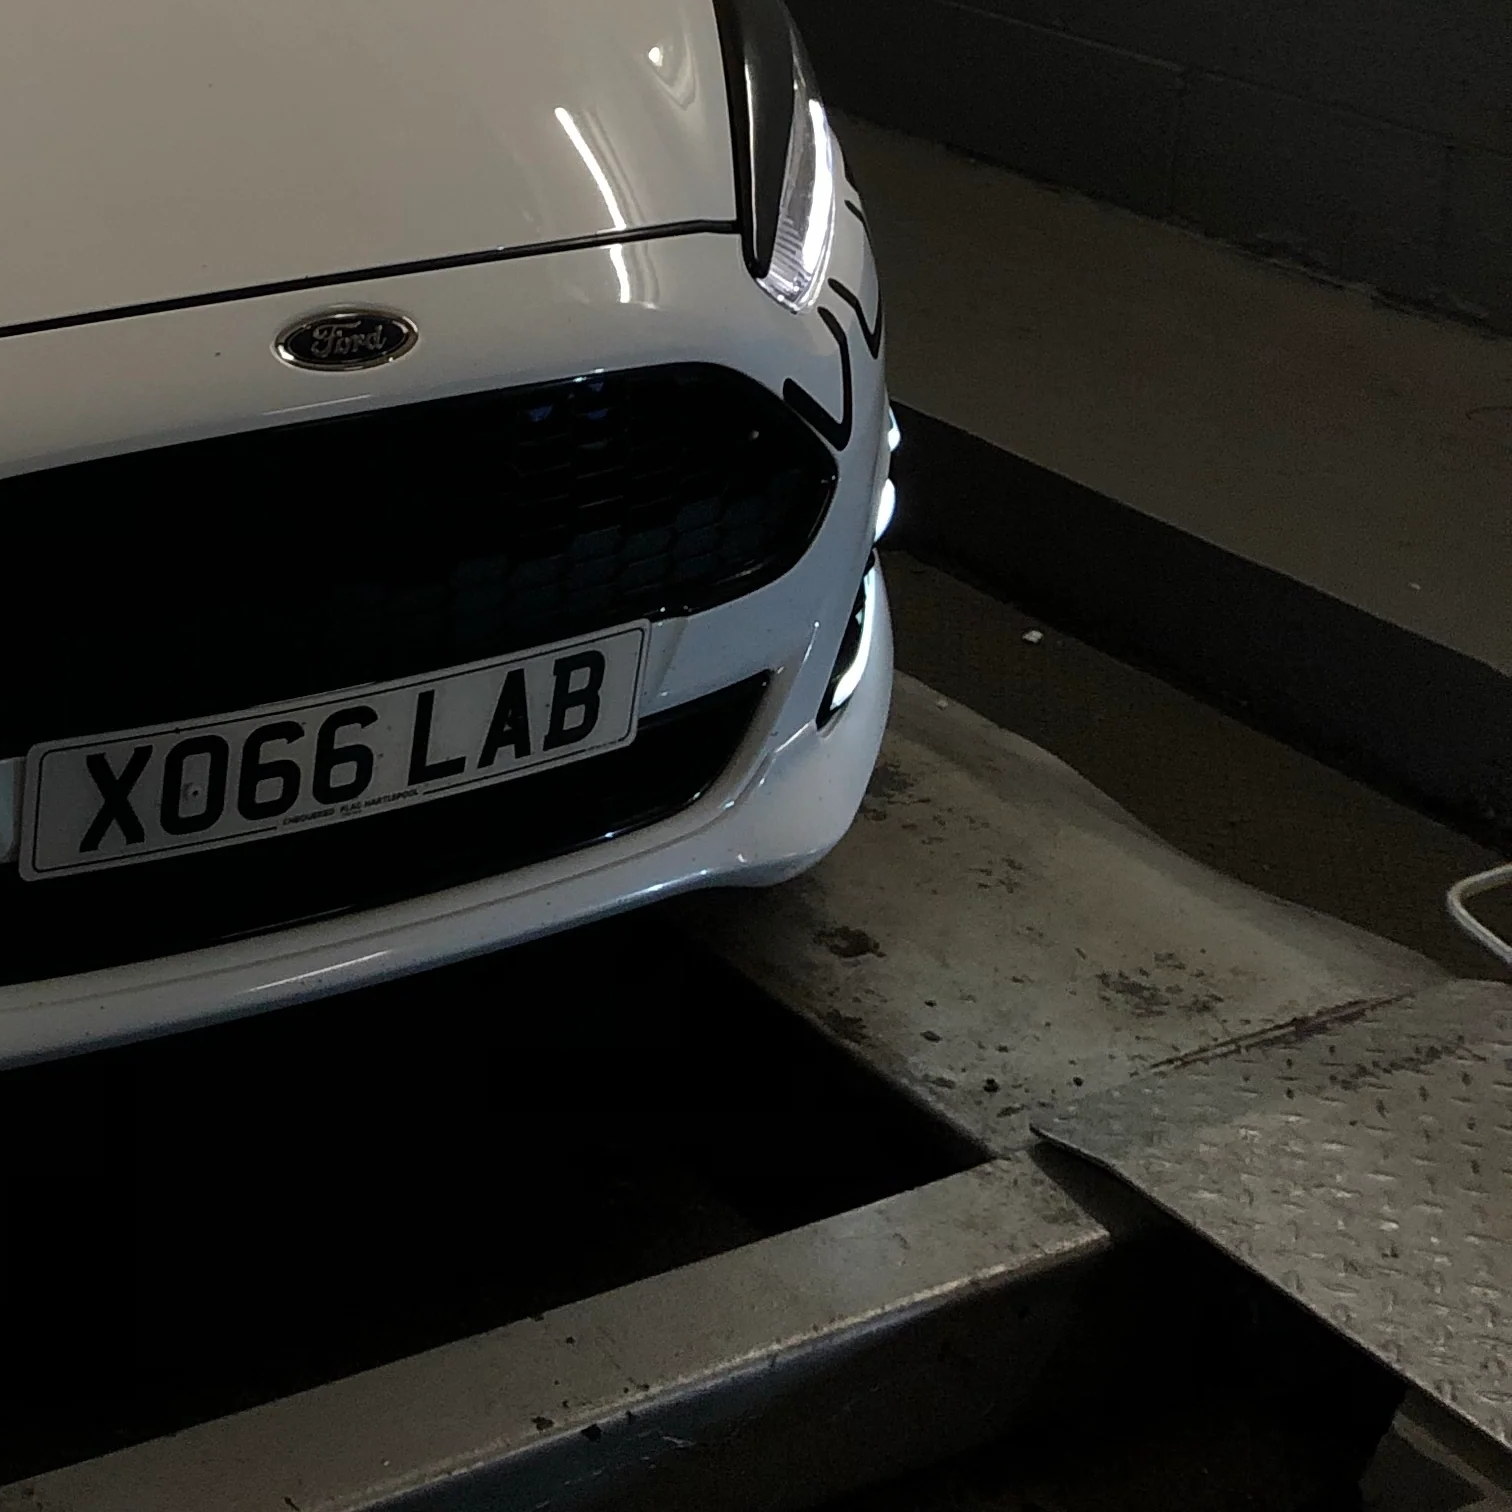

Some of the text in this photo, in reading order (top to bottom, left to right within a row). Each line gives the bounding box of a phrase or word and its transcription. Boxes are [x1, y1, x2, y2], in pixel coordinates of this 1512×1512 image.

[311, 320, 387, 358] Ford
[78, 649, 608, 853] XO66 LAB
[364, 789, 419, 807] HARTLEPOOL
